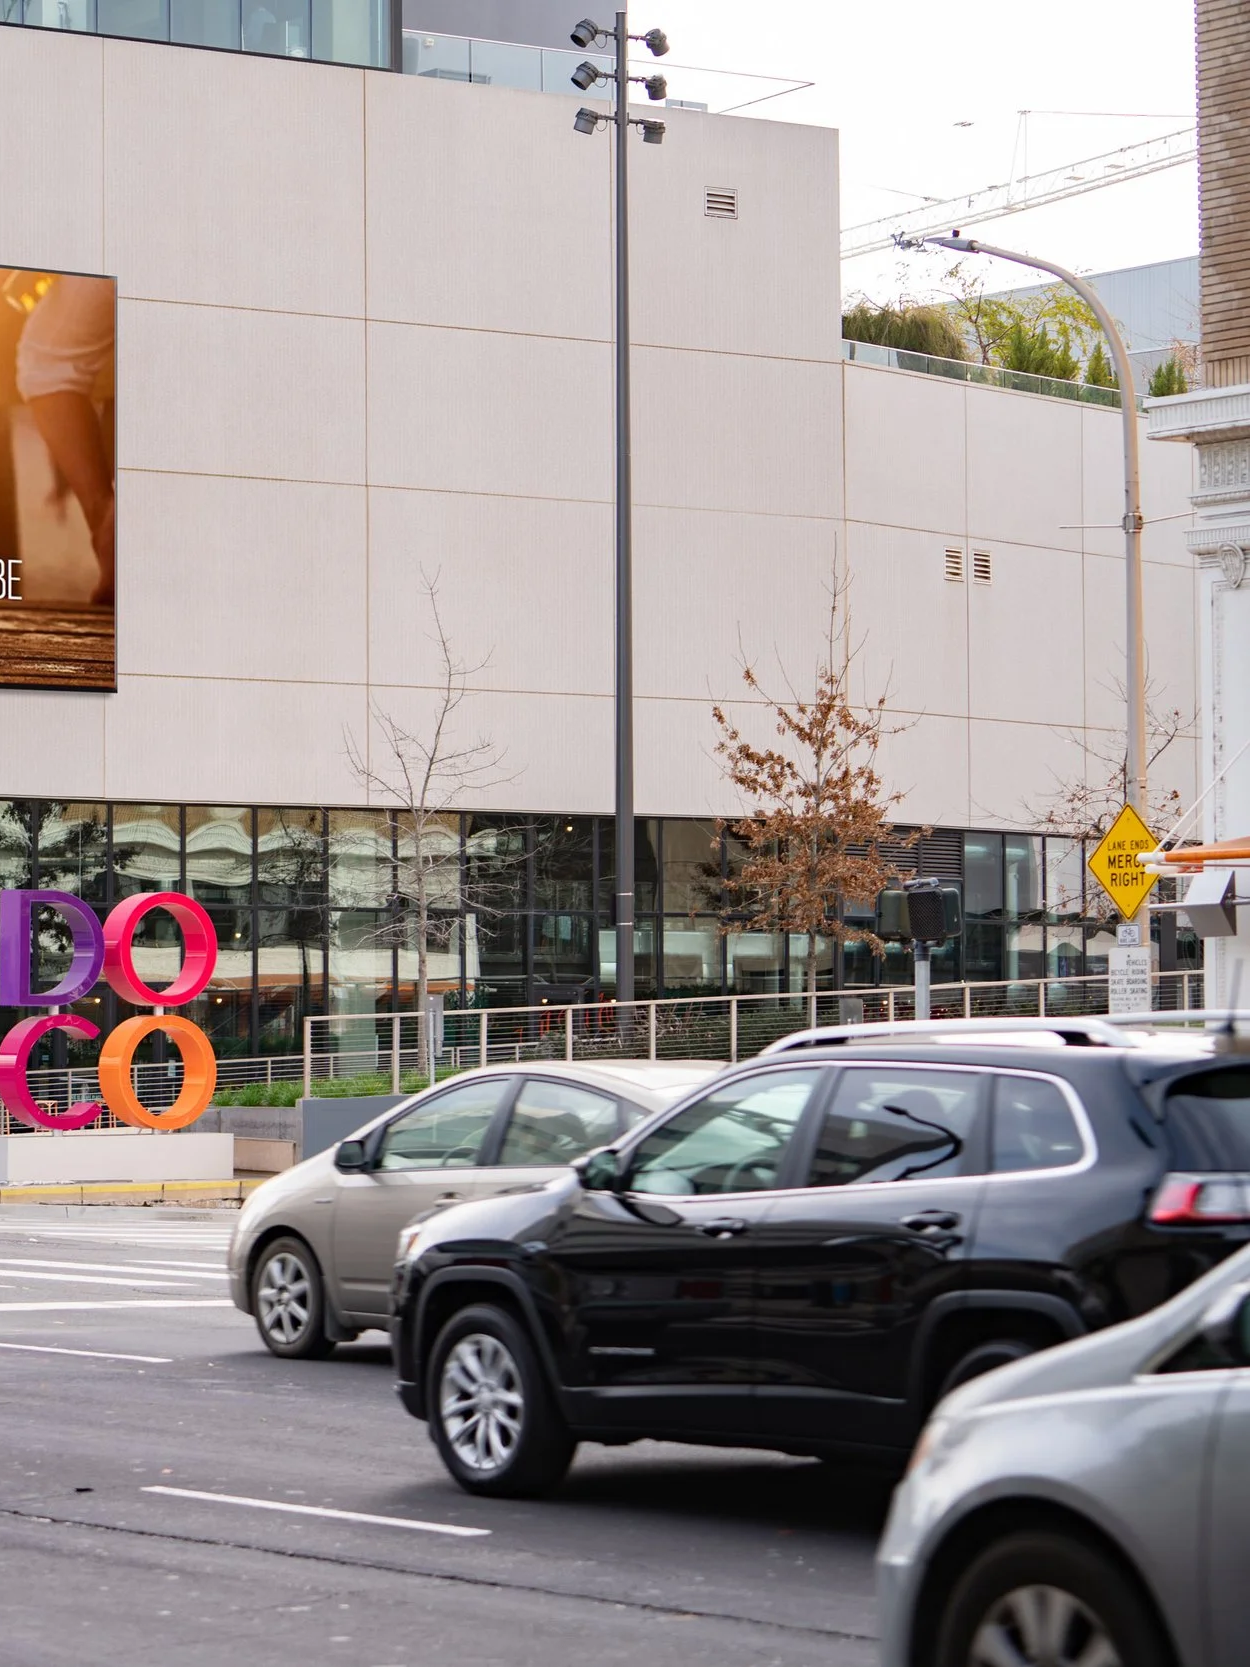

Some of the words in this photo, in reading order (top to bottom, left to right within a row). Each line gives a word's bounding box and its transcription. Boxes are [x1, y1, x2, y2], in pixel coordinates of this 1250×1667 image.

[1107, 840, 1126, 851] LANE
[1130, 839, 1149, 850] ENDS
[1107, 853, 1146, 869] MERG
[1110, 871, 1146, 887] RIGHT
